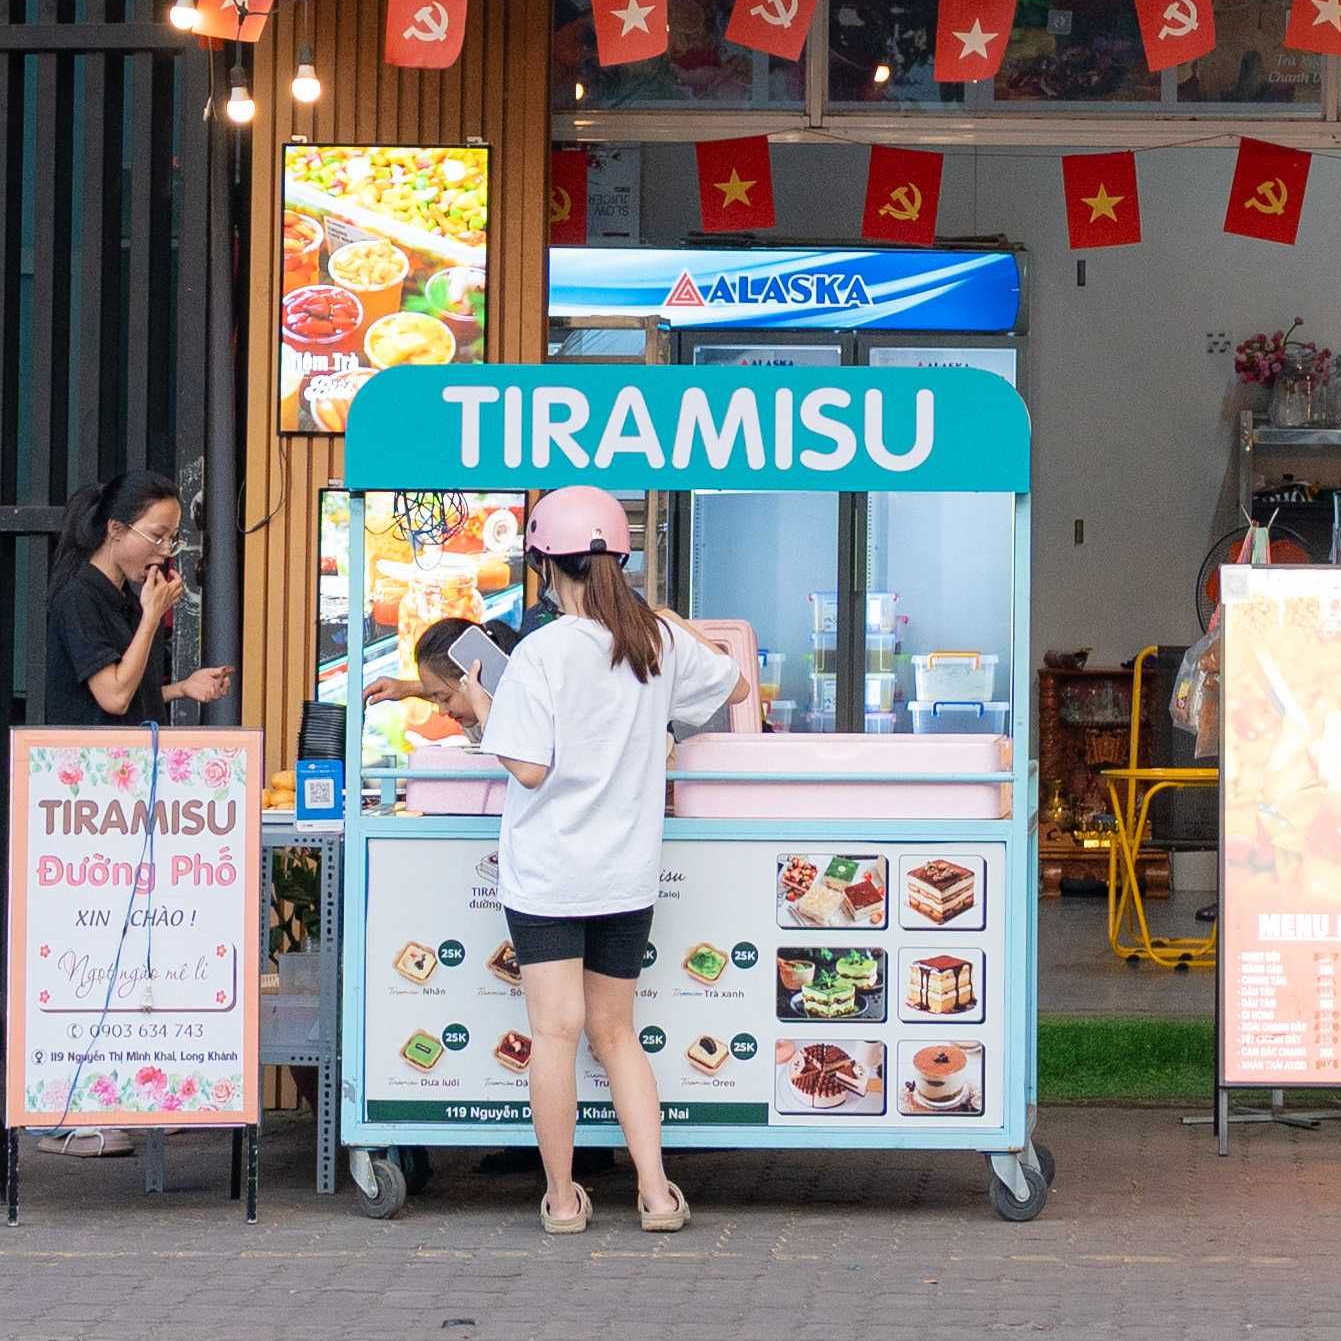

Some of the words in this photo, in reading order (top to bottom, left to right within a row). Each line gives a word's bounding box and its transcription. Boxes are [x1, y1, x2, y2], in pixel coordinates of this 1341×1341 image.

[709, 272, 873, 307] ALASKA
[443, 385, 935, 472] TIRAMISU
[38, 799, 237, 836] TIRAMISU
[36, 853, 157, 895] Đường
[171, 845, 238, 887] Phố
[75, 909, 111, 927] XIN
[129, 905, 184, 928] CHÀO
[1258, 913, 1329, 939] MENU
[440, 948, 463, 959] 25K
[734, 950, 756, 961] 25K
[89, 1023, 133, 1038] 0903
[138, 1023, 168, 1038] 634
[174, 1023, 204, 1038] 743
[445, 1032, 467, 1043] 25K
[642, 1034, 663, 1045] 25K
[733, 1042, 755, 1052] 25K
[50, 1051, 64, 1061] 119
[126, 1051, 151, 1061] Minh
[180, 1051, 205, 1063] Long
[208, 1050, 238, 1061] Khánh
[445, 1106, 467, 1118] 119
[470, 1105, 518, 1120] Nguyễn
[583, 1106, 615, 1118] Khán
[668, 1108, 689, 1119] Nai
